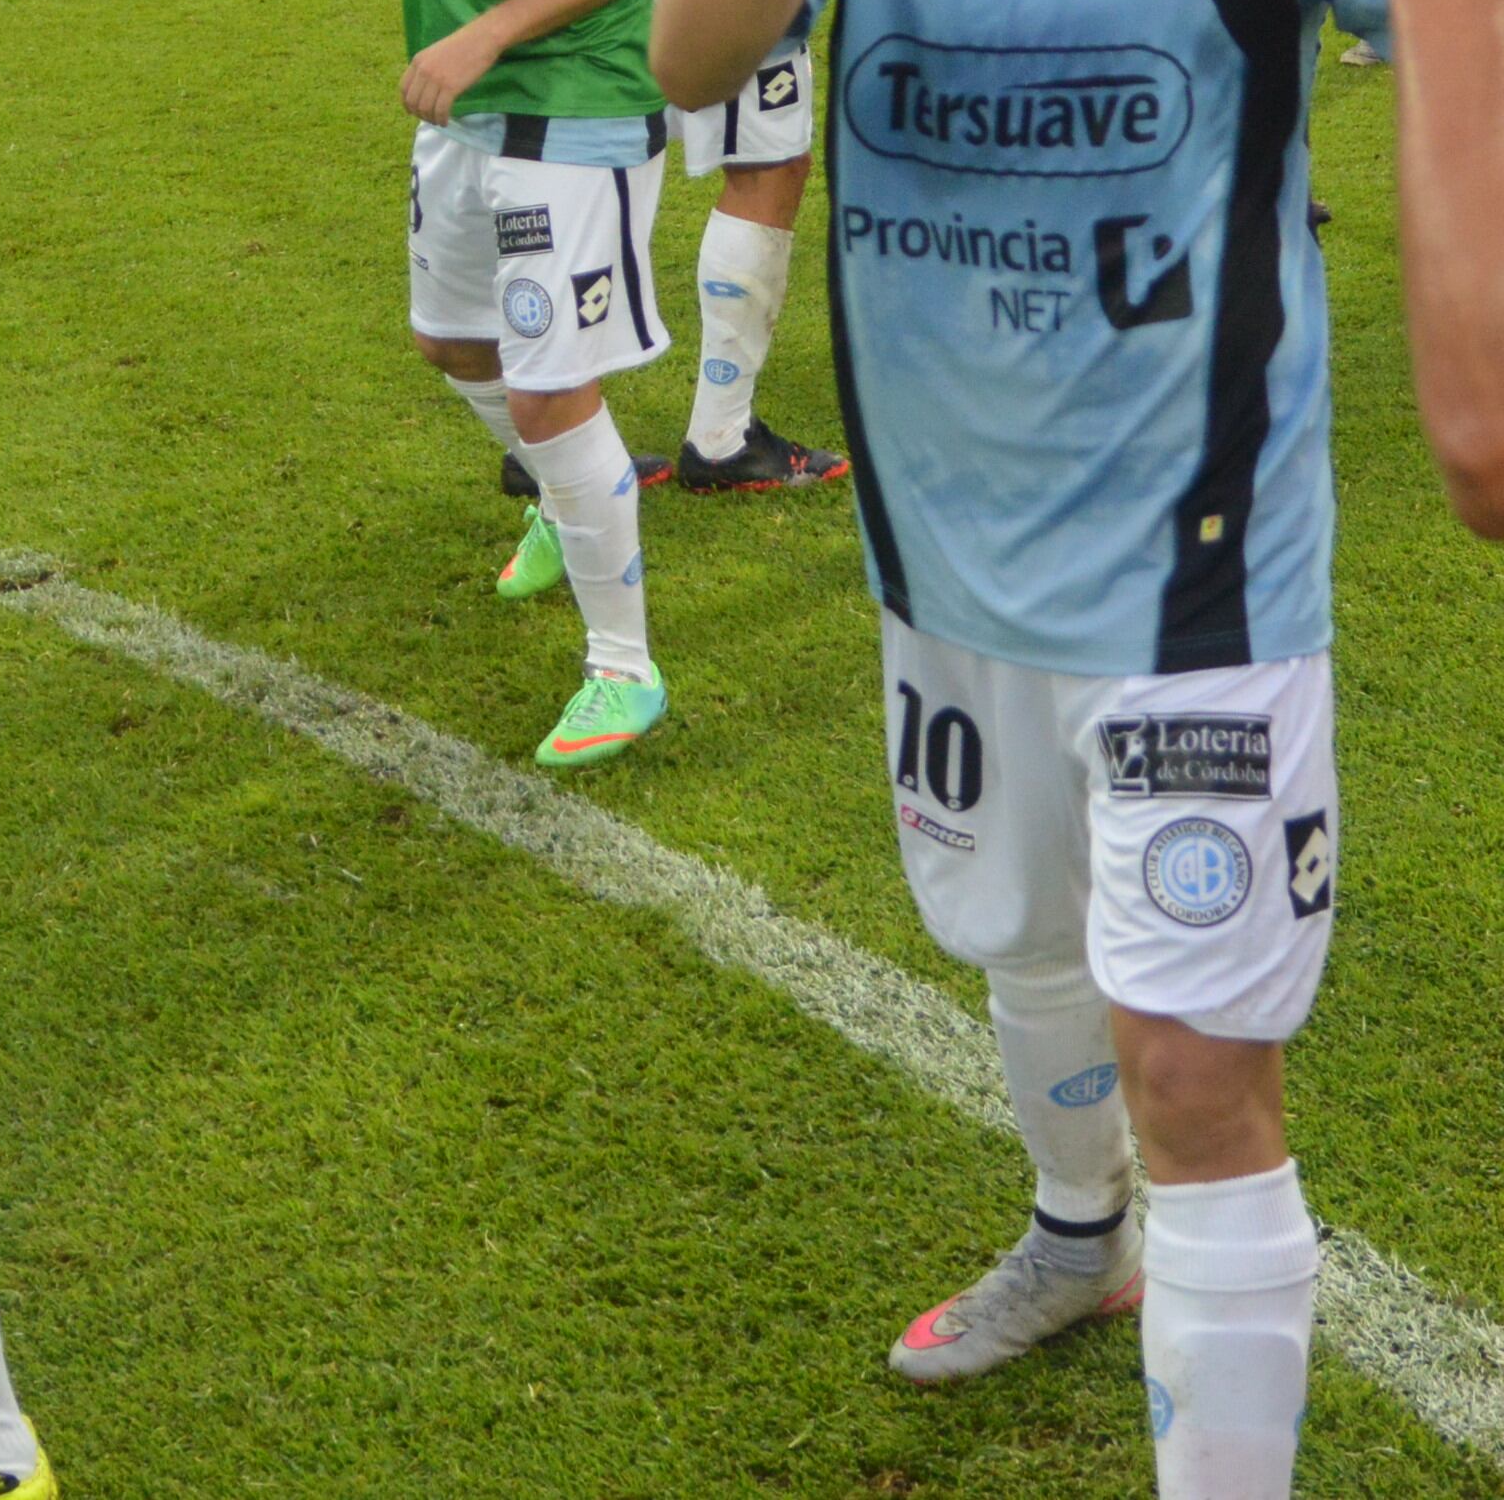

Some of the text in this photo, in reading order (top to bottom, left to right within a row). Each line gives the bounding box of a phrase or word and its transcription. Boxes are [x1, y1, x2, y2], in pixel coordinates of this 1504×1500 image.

[878, 61, 1160, 148] Tersuave
[843, 205, 1071, 274] Provincia
[990, 286, 1070, 332] NET
[897, 679, 983, 813] 10
[1156, 720, 1269, 756] Lotería
[1155, 759, 1267, 785] de Córdoba
